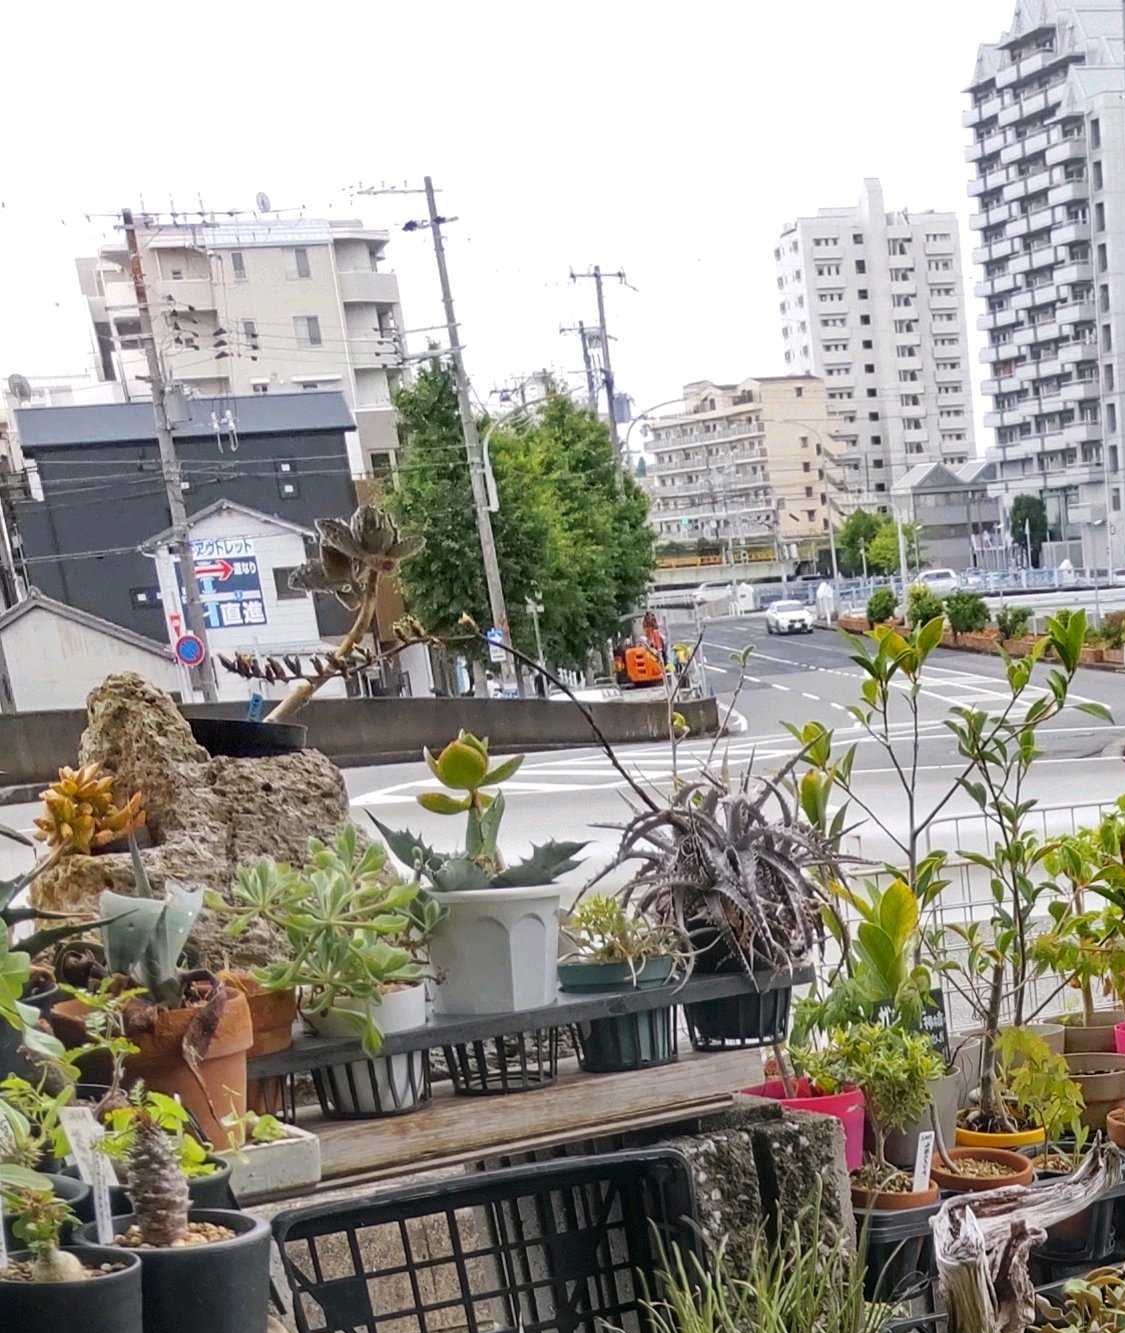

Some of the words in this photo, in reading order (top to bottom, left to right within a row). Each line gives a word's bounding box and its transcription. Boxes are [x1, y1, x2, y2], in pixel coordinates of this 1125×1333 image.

[195, 540, 252, 556] アウトレット
[220, 600, 266, 626] 直進
